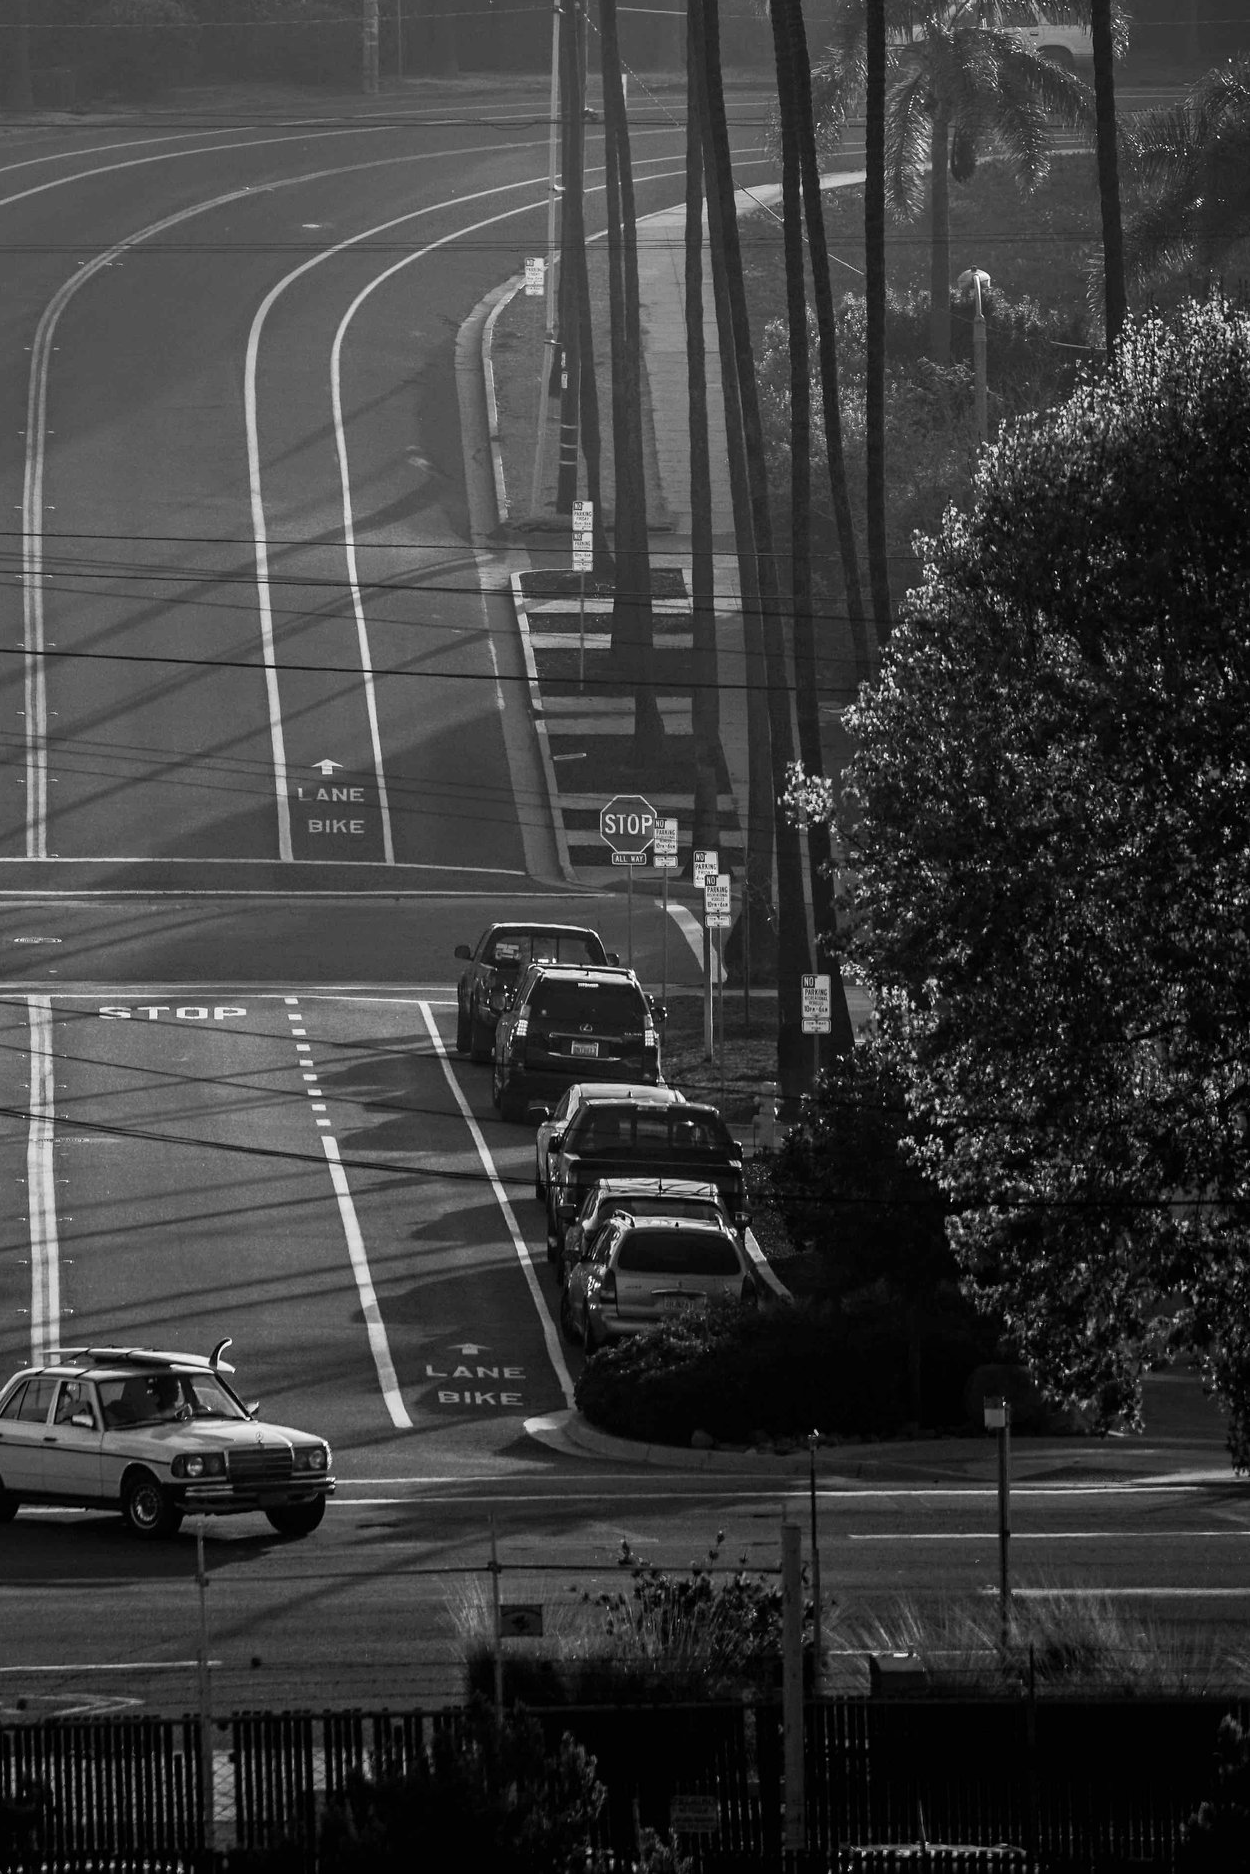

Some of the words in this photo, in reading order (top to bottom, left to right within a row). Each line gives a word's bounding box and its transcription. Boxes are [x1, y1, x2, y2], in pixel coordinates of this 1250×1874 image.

[298, 788, 364, 801] LANE
[309, 819, 364, 833] BIKE
[605, 814, 653, 835] STOP
[655, 819, 664, 828] NO
[695, 853, 705, 861] NO
[706, 876, 716, 885] NO
[804, 976, 814, 987] NO
[99, 1007, 247, 1020] STOP
[426, 1365, 527, 1379] LANE
[438, 1391, 524, 1406] BIKE
